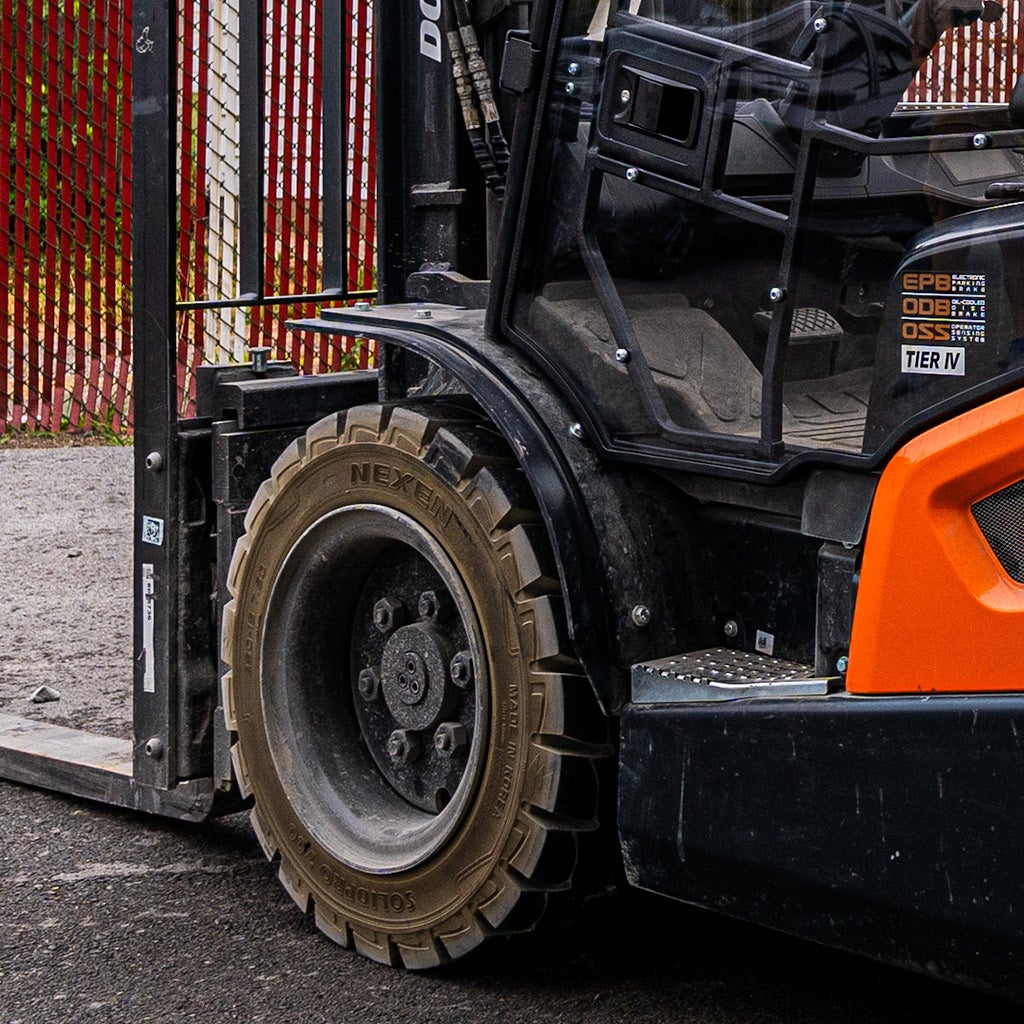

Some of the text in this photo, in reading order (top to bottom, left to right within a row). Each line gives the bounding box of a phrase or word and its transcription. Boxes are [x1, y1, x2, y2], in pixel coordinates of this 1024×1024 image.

[902, 273, 951, 292] EPB
[902, 297, 951, 316] ODB
[902, 322, 951, 341] OSS
[951, 323, 986, 331] OPERATOR
[905, 350, 961, 370] TIER IV
[350, 461, 455, 529] NEXEN
[492, 682, 518, 818] MADE IN KOREA
[319, 862, 417, 913] SOLIDPRO
